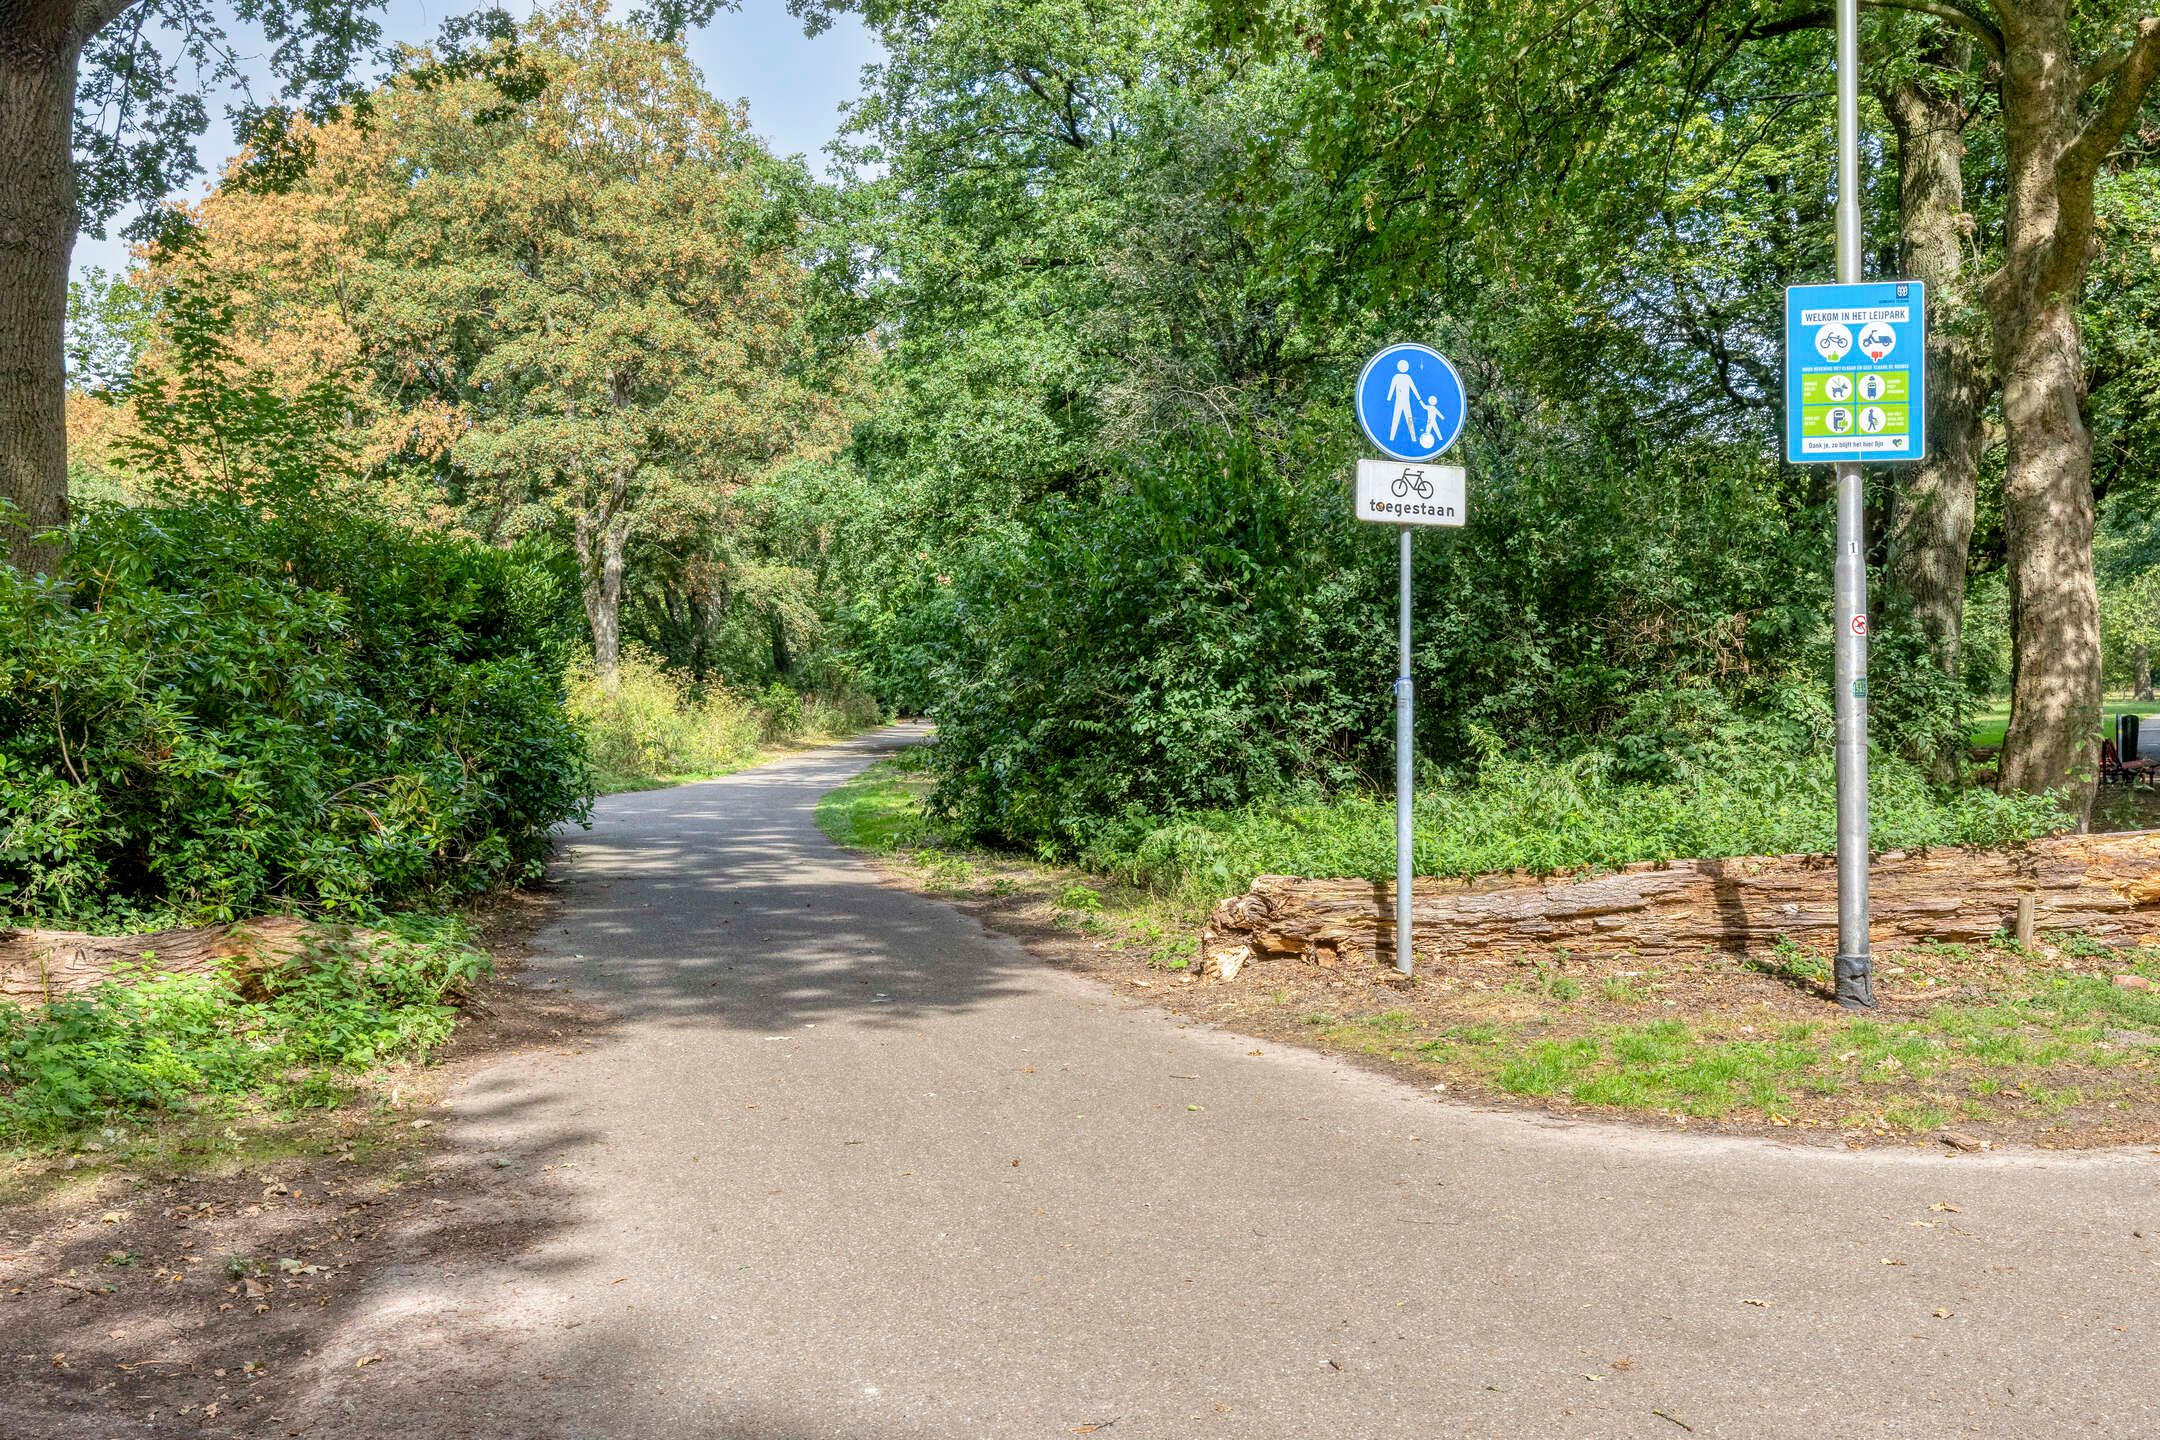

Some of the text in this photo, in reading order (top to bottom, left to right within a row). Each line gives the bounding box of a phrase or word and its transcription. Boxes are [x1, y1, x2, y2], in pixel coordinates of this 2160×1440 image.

[1805, 309, 1906, 322] WELKOM IN HET LEIJPARK
[1369, 499, 1455, 517] toegestaan
[1850, 542, 1856, 553] 1
